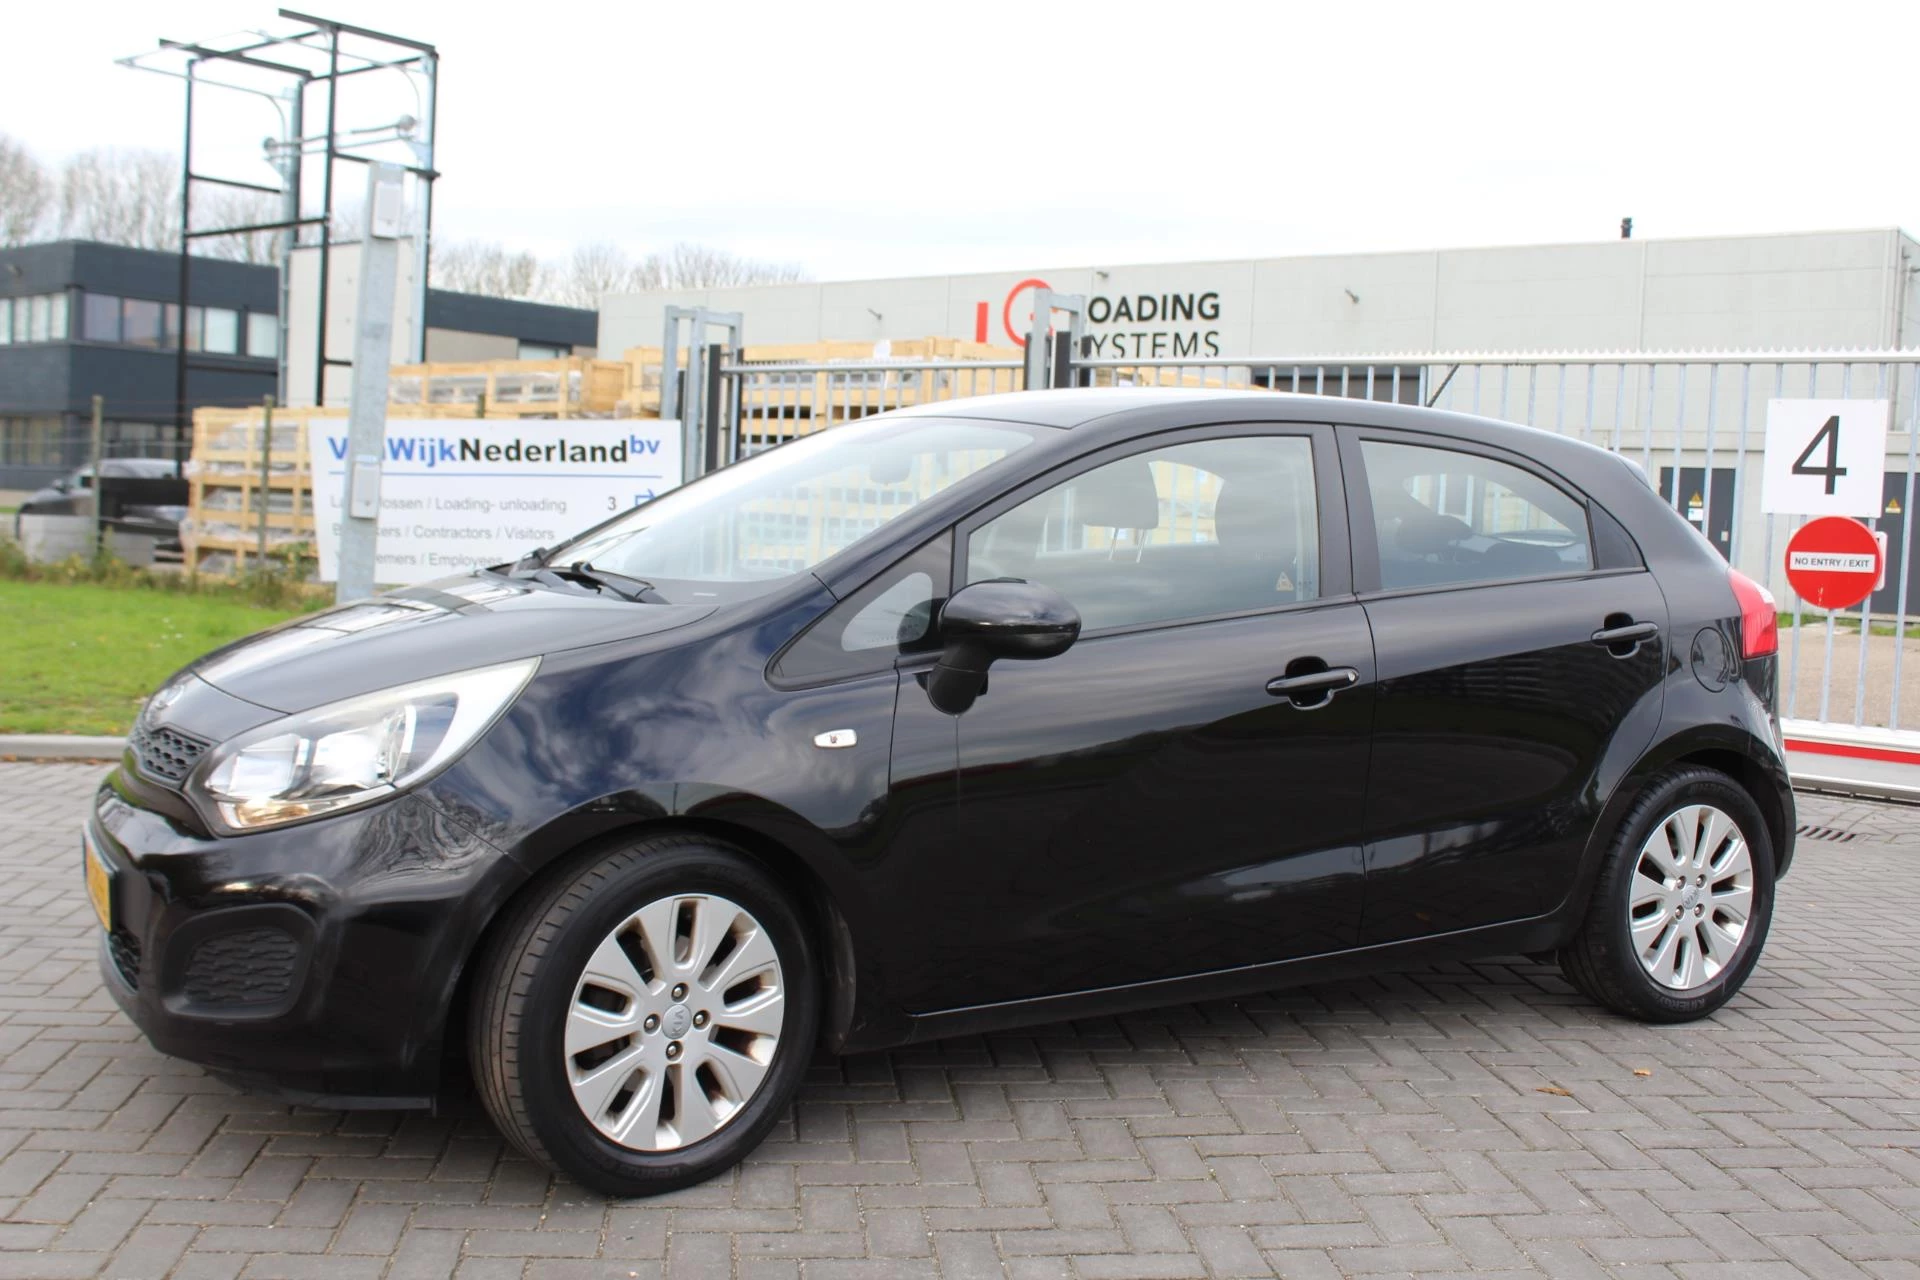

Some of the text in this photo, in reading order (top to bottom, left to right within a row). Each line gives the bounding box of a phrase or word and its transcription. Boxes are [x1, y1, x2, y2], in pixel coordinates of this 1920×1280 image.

[1088, 292, 1220, 323] OADING
[1090, 331, 1220, 359] YSTEMS
[1792, 415, 1847, 495] 4
[499, 498, 568, 515] unloading
[607, 496, 617, 511] 3
[412, 524, 493, 539] Contractors
[504, 526, 556, 540] Visitors
[1794, 557, 1809, 565] NO
[1811, 558, 1841, 567] ENTRY
[1849, 559, 1870, 567] EXIT
